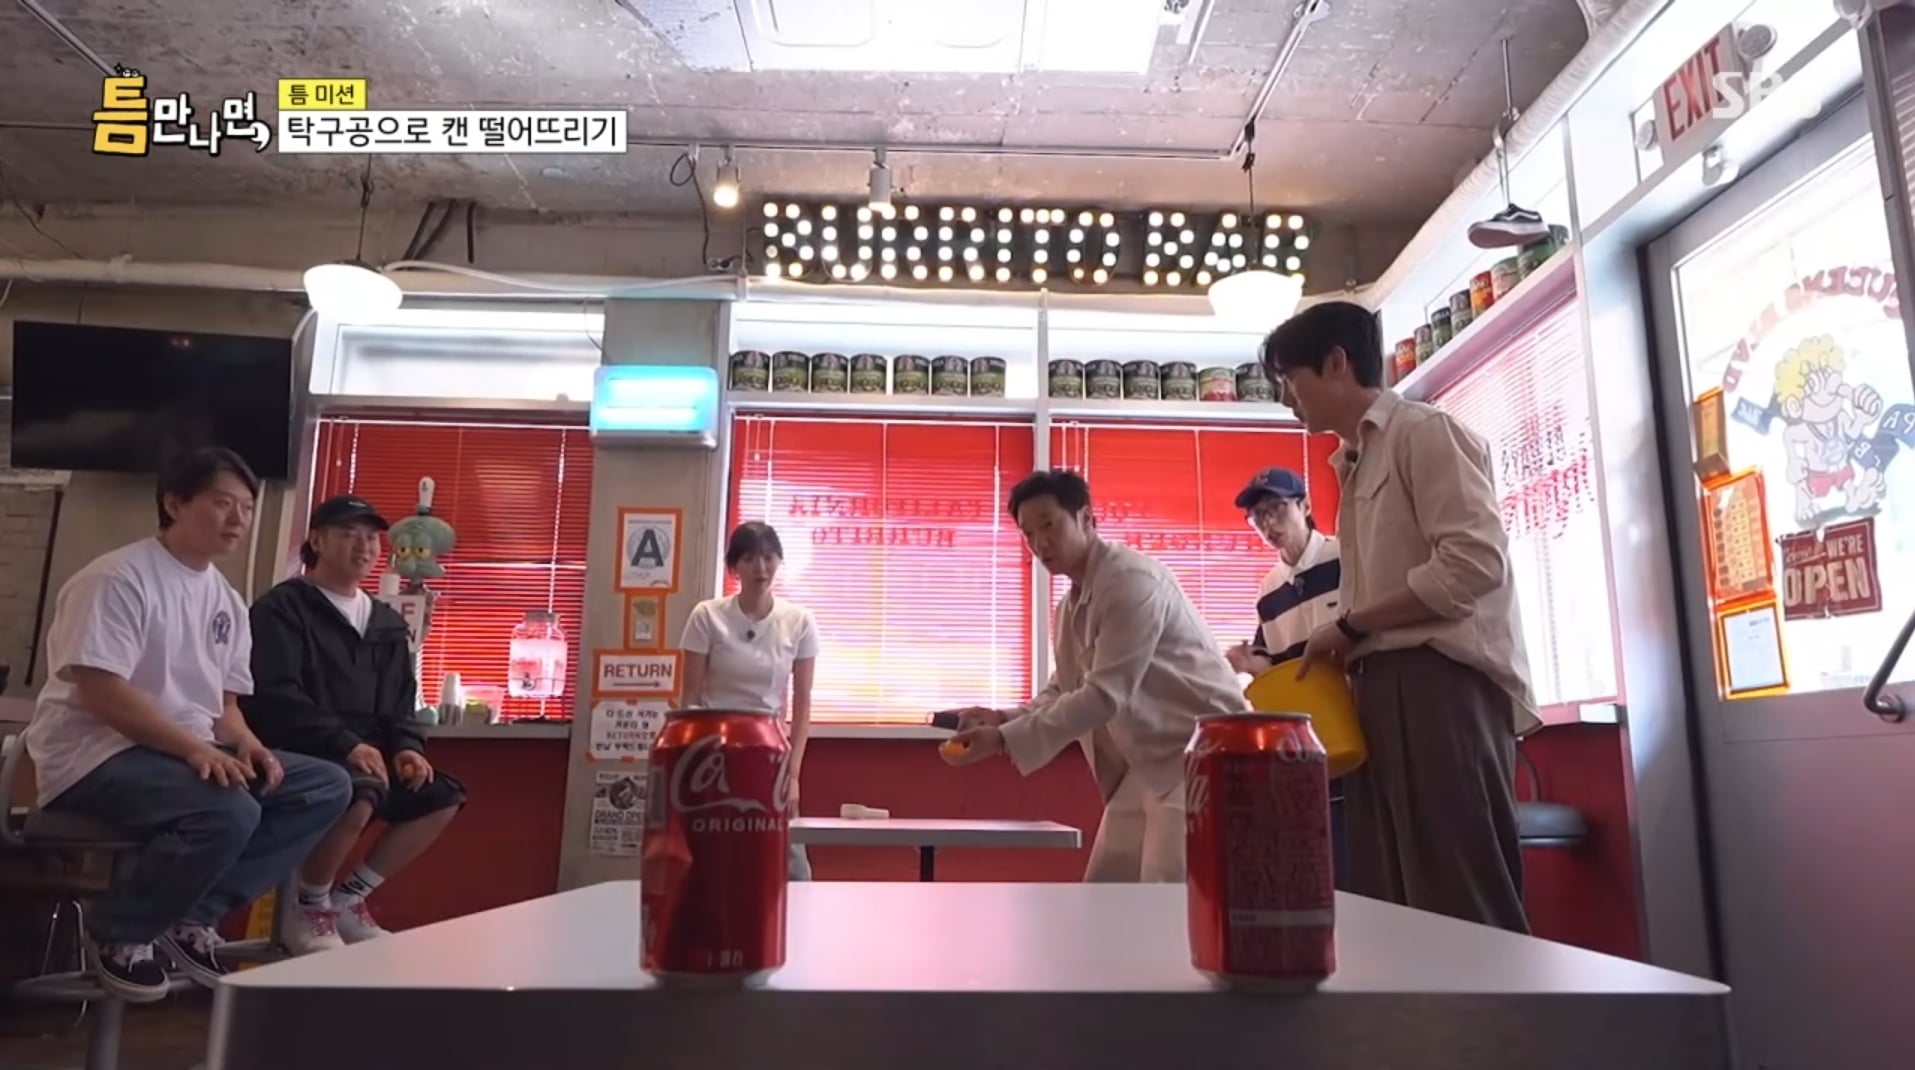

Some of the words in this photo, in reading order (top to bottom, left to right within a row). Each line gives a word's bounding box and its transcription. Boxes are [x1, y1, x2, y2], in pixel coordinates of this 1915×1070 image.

[1663, 36, 1724, 141] EXIT
[763, 201, 1121, 285] BURRITO
[1143, 210, 1313, 287] BAR
[630, 528, 664, 567] A
[1826, 533, 1864, 559] WE'RE
[1784, 557, 1871, 608] OPEN
[603, 663, 672, 678] RETURN
[692, 817, 784, 833] ORIGINAL
